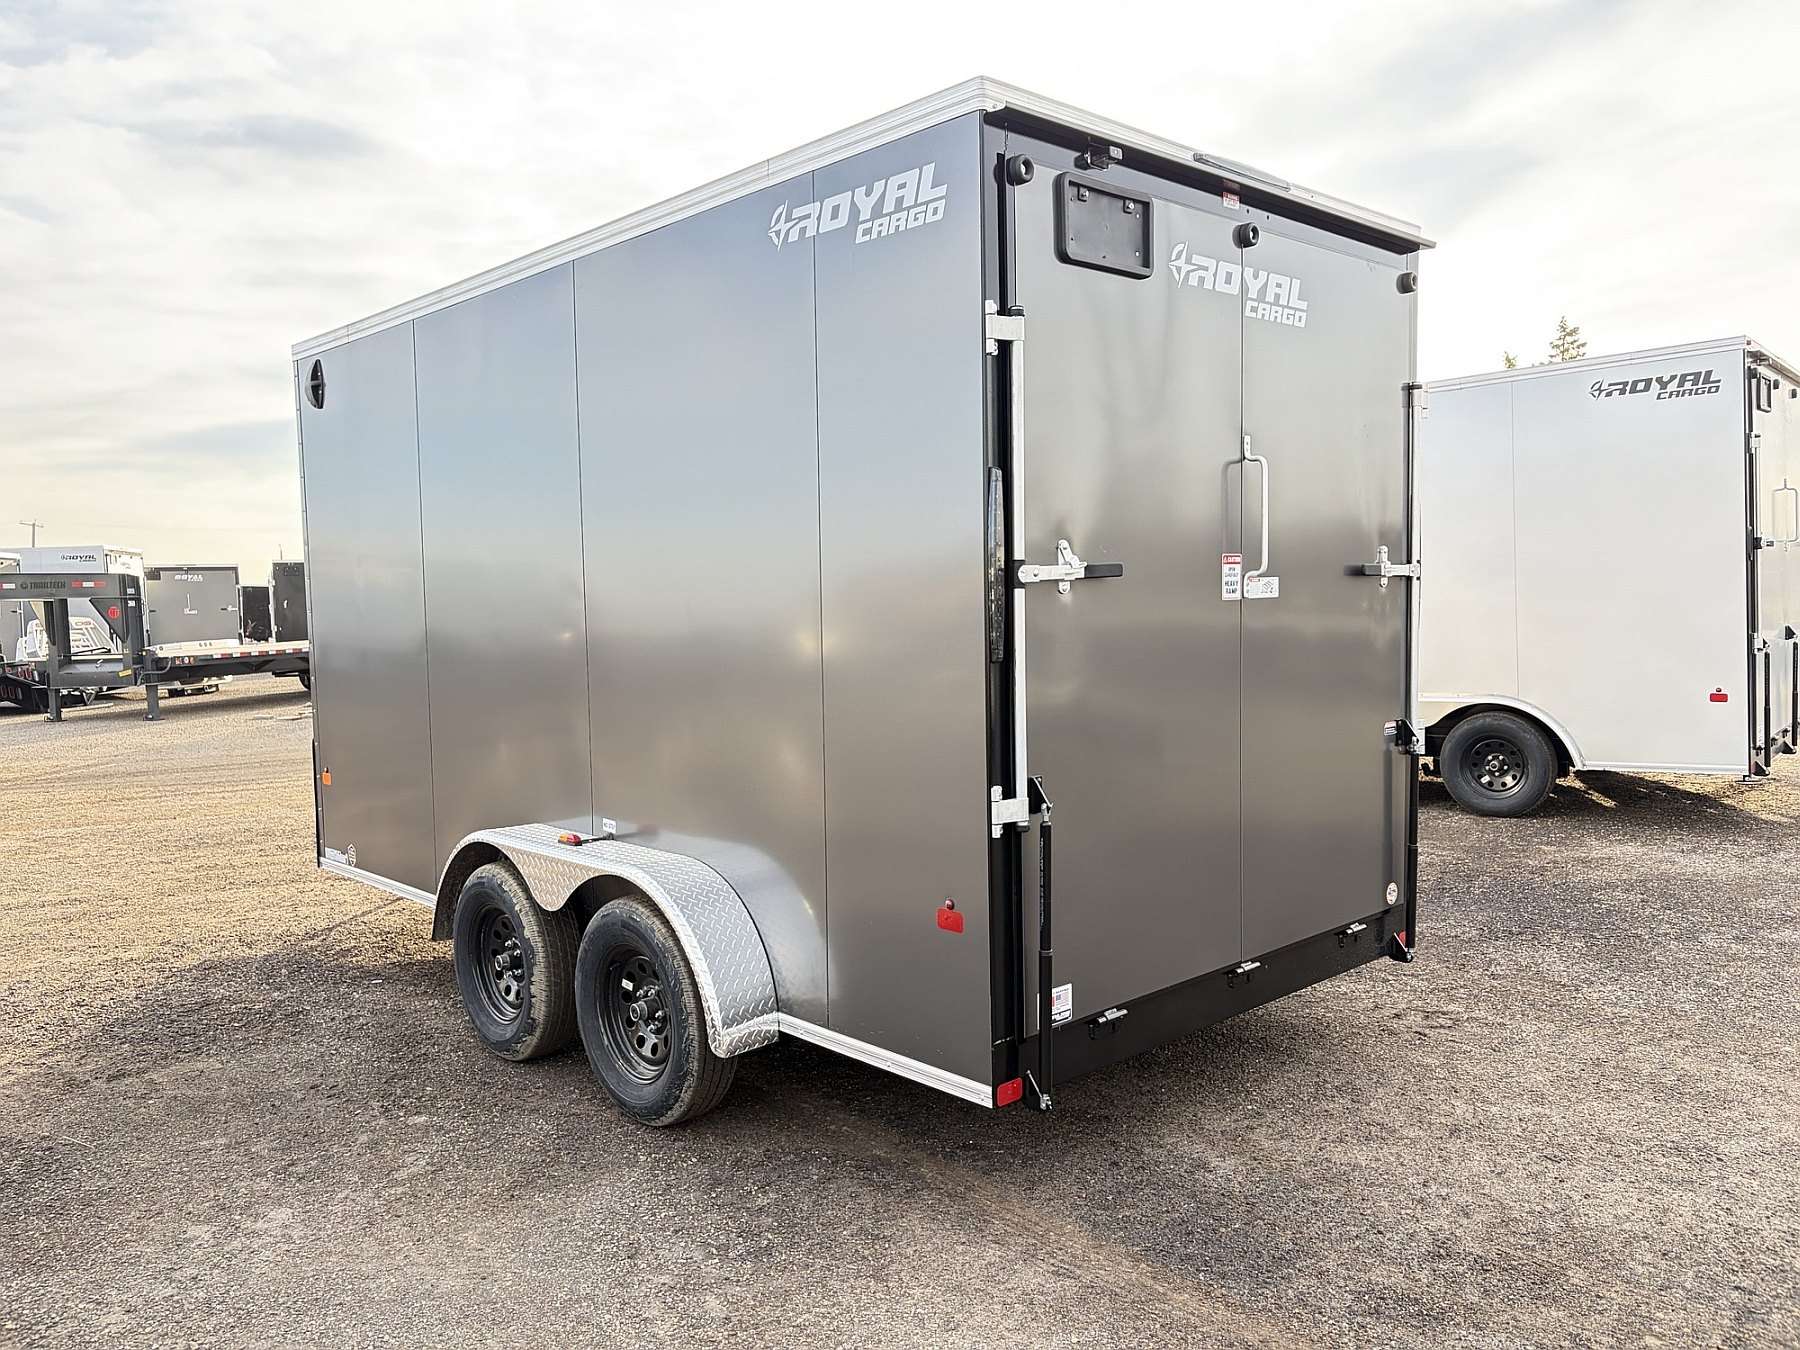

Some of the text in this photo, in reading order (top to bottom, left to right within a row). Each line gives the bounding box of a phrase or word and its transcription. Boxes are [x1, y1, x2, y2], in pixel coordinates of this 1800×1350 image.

[787, 162, 948, 243] ROYAL
[855, 199, 947, 244] CARGO
[1188, 254, 1308, 310] ROYAL
[1244, 299, 1307, 328] CARGO
[1604, 369, 1721, 397] ROYAL
[1656, 385, 1721, 401] CARGO
[29, 581, 66, 590] TRAILTECH
